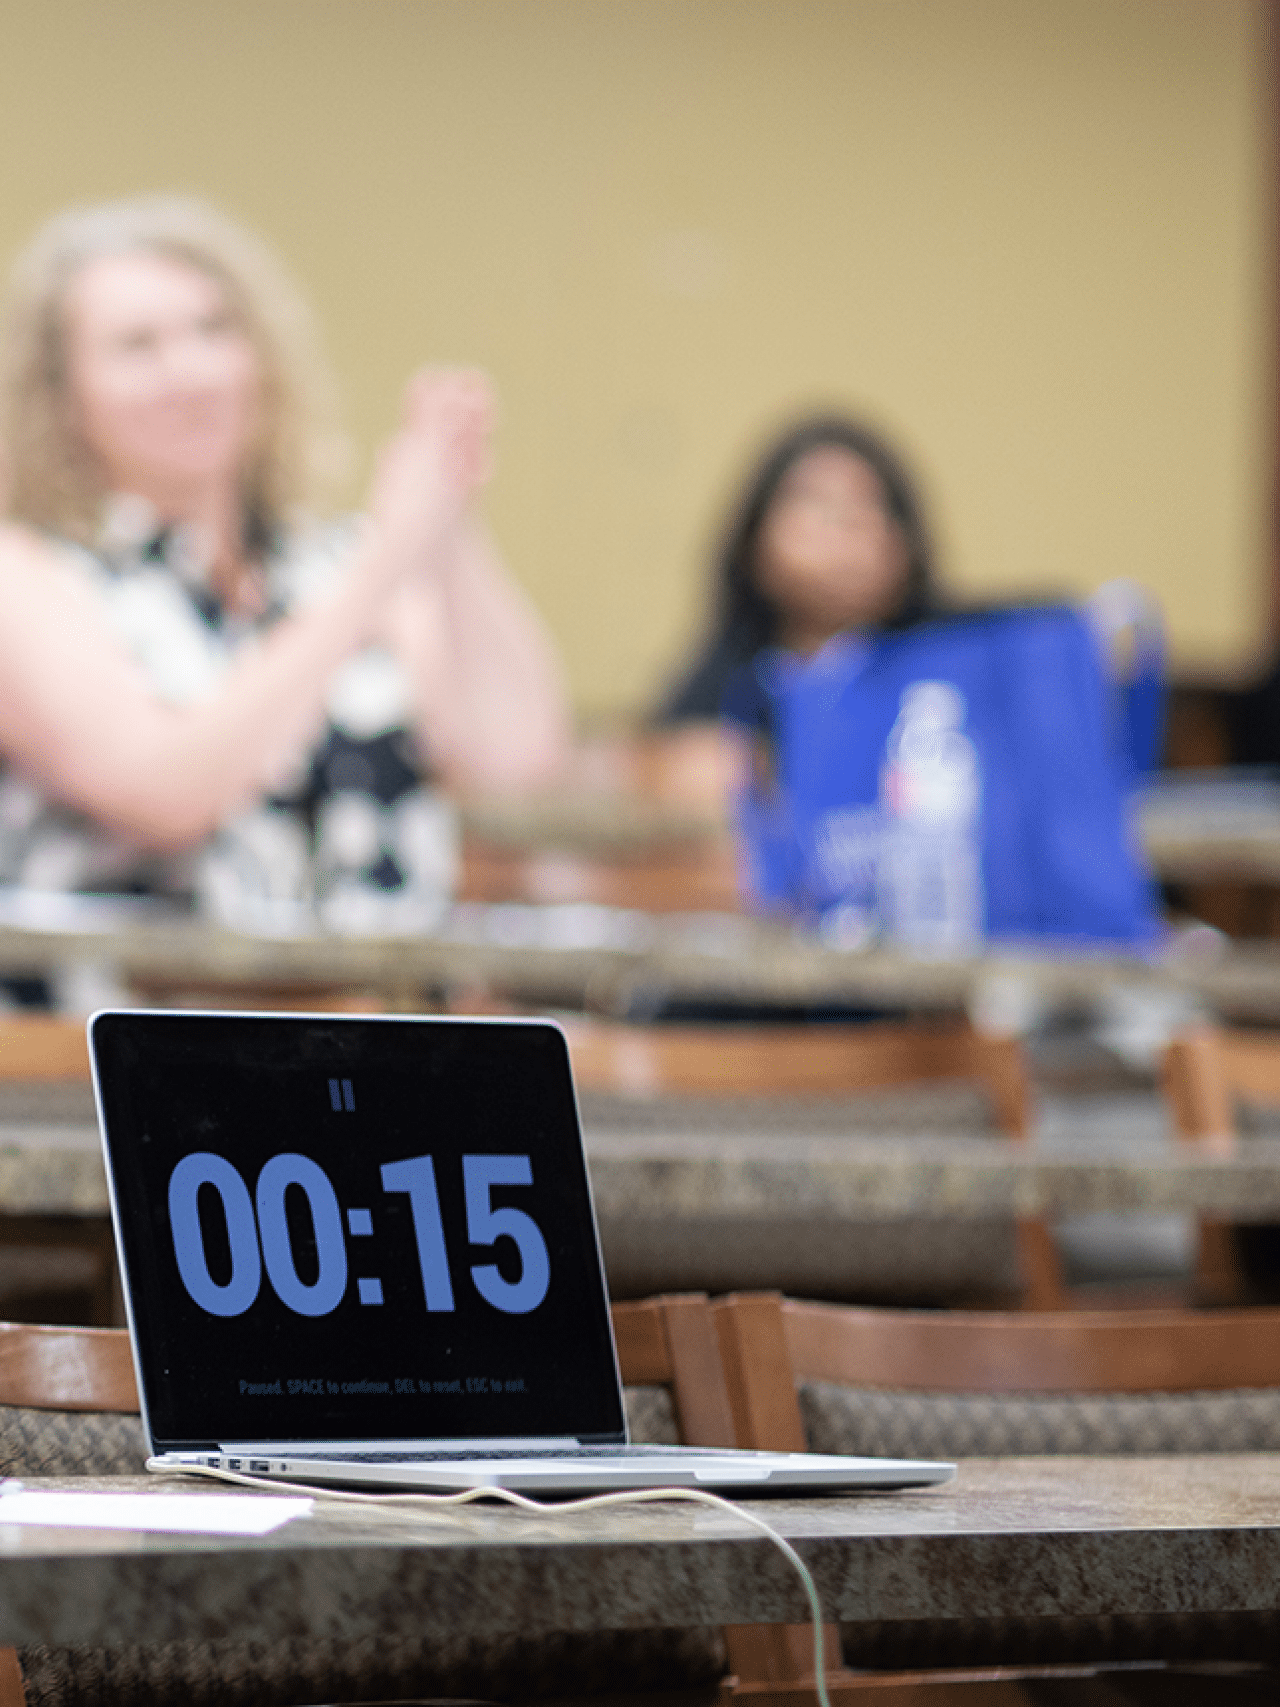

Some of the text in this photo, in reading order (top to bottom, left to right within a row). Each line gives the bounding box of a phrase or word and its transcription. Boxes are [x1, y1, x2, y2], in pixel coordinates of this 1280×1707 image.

[168, 1152, 551, 1318] 00:15
[238, 1378, 285, 1396] Paused.
[286, 1378, 325, 1395] SPACE
[326, 1380, 340, 1395] to
[418, 1379, 432, 1394] to
[465, 1377, 489, 1393] ESC
[489, 1379, 503, 1393] to
